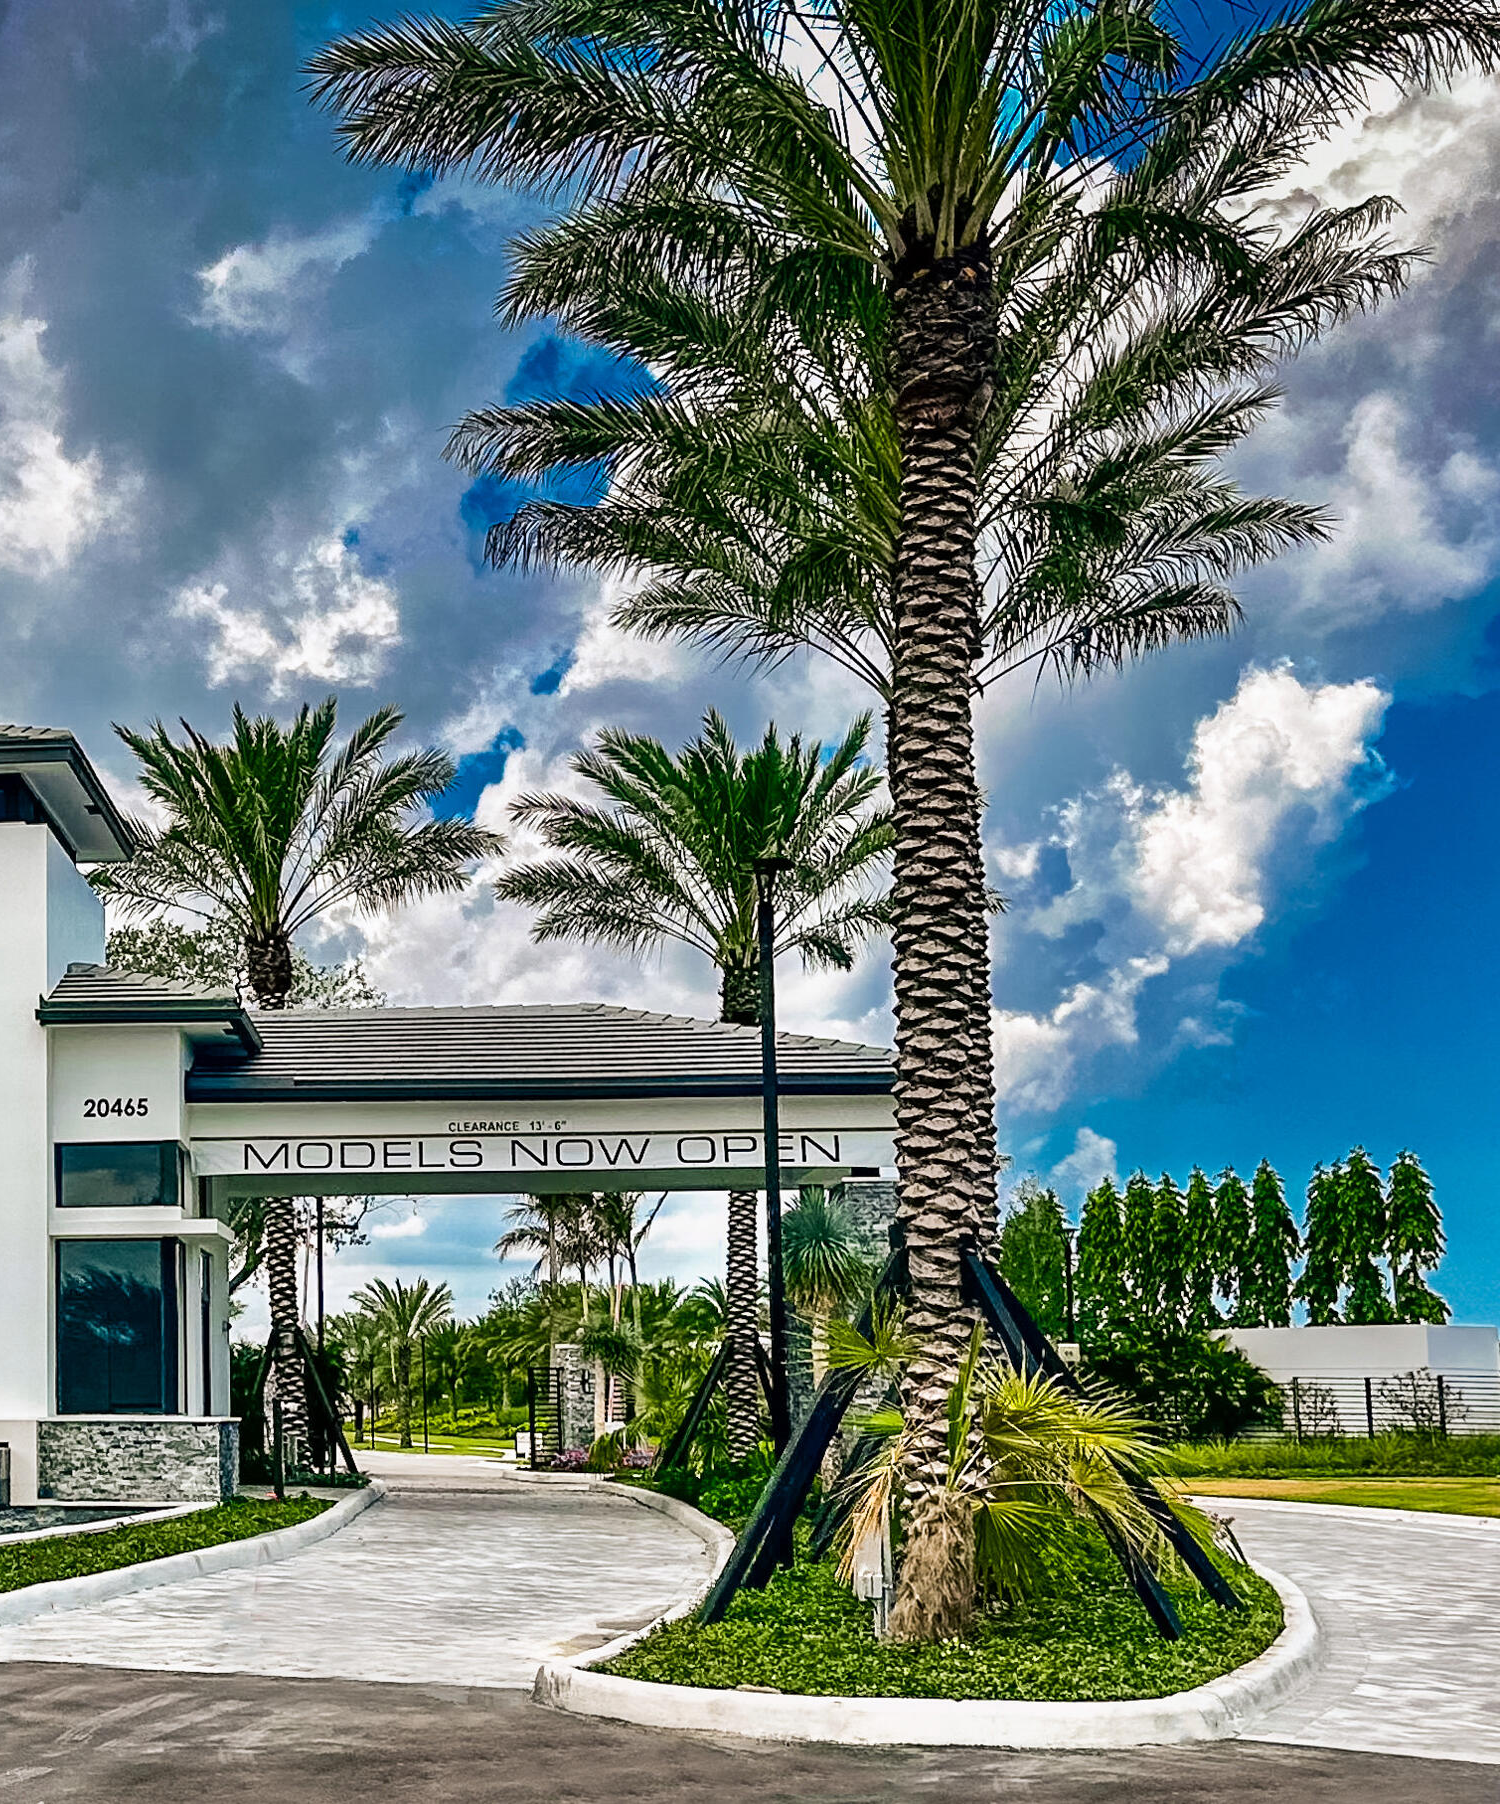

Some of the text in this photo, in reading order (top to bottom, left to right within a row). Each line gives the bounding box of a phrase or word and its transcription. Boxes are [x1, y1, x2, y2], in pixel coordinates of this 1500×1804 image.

[83, 1097, 149, 1118] 20465
[448, 1121, 520, 1132] CLEARANCE
[244, 1135, 840, 1170] MODELS NOW OPEN
